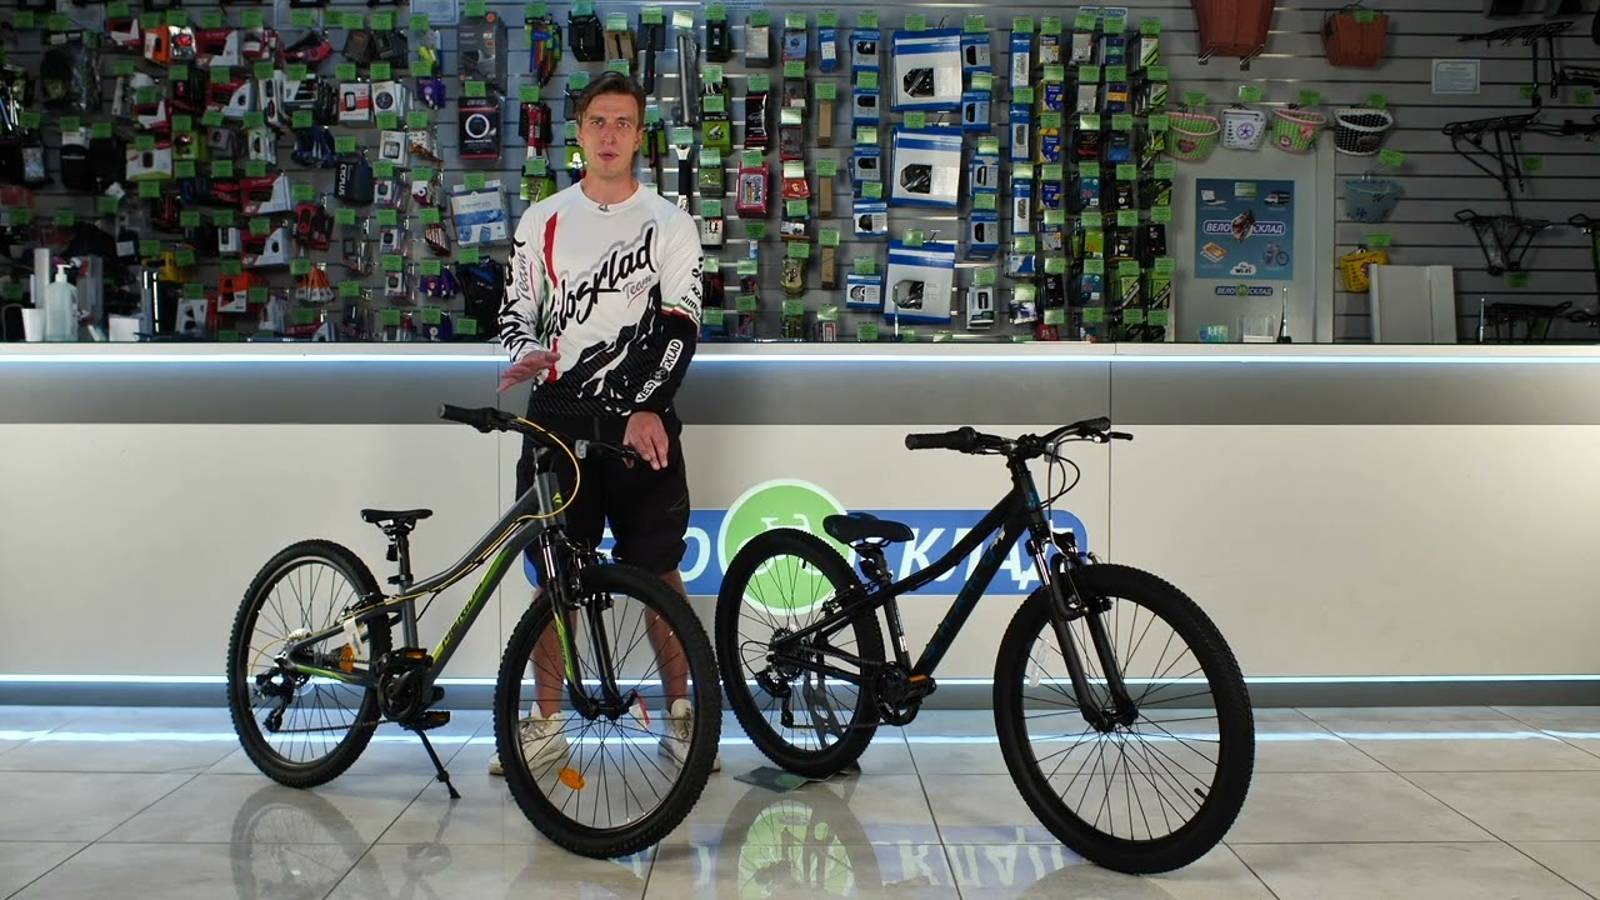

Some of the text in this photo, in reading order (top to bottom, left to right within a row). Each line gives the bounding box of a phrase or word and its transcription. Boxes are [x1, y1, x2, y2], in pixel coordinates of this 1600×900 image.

[1253, 223, 1283, 235] СКЛАД
[514, 251, 531, 302] Team
[622, 274, 653, 300] Team
